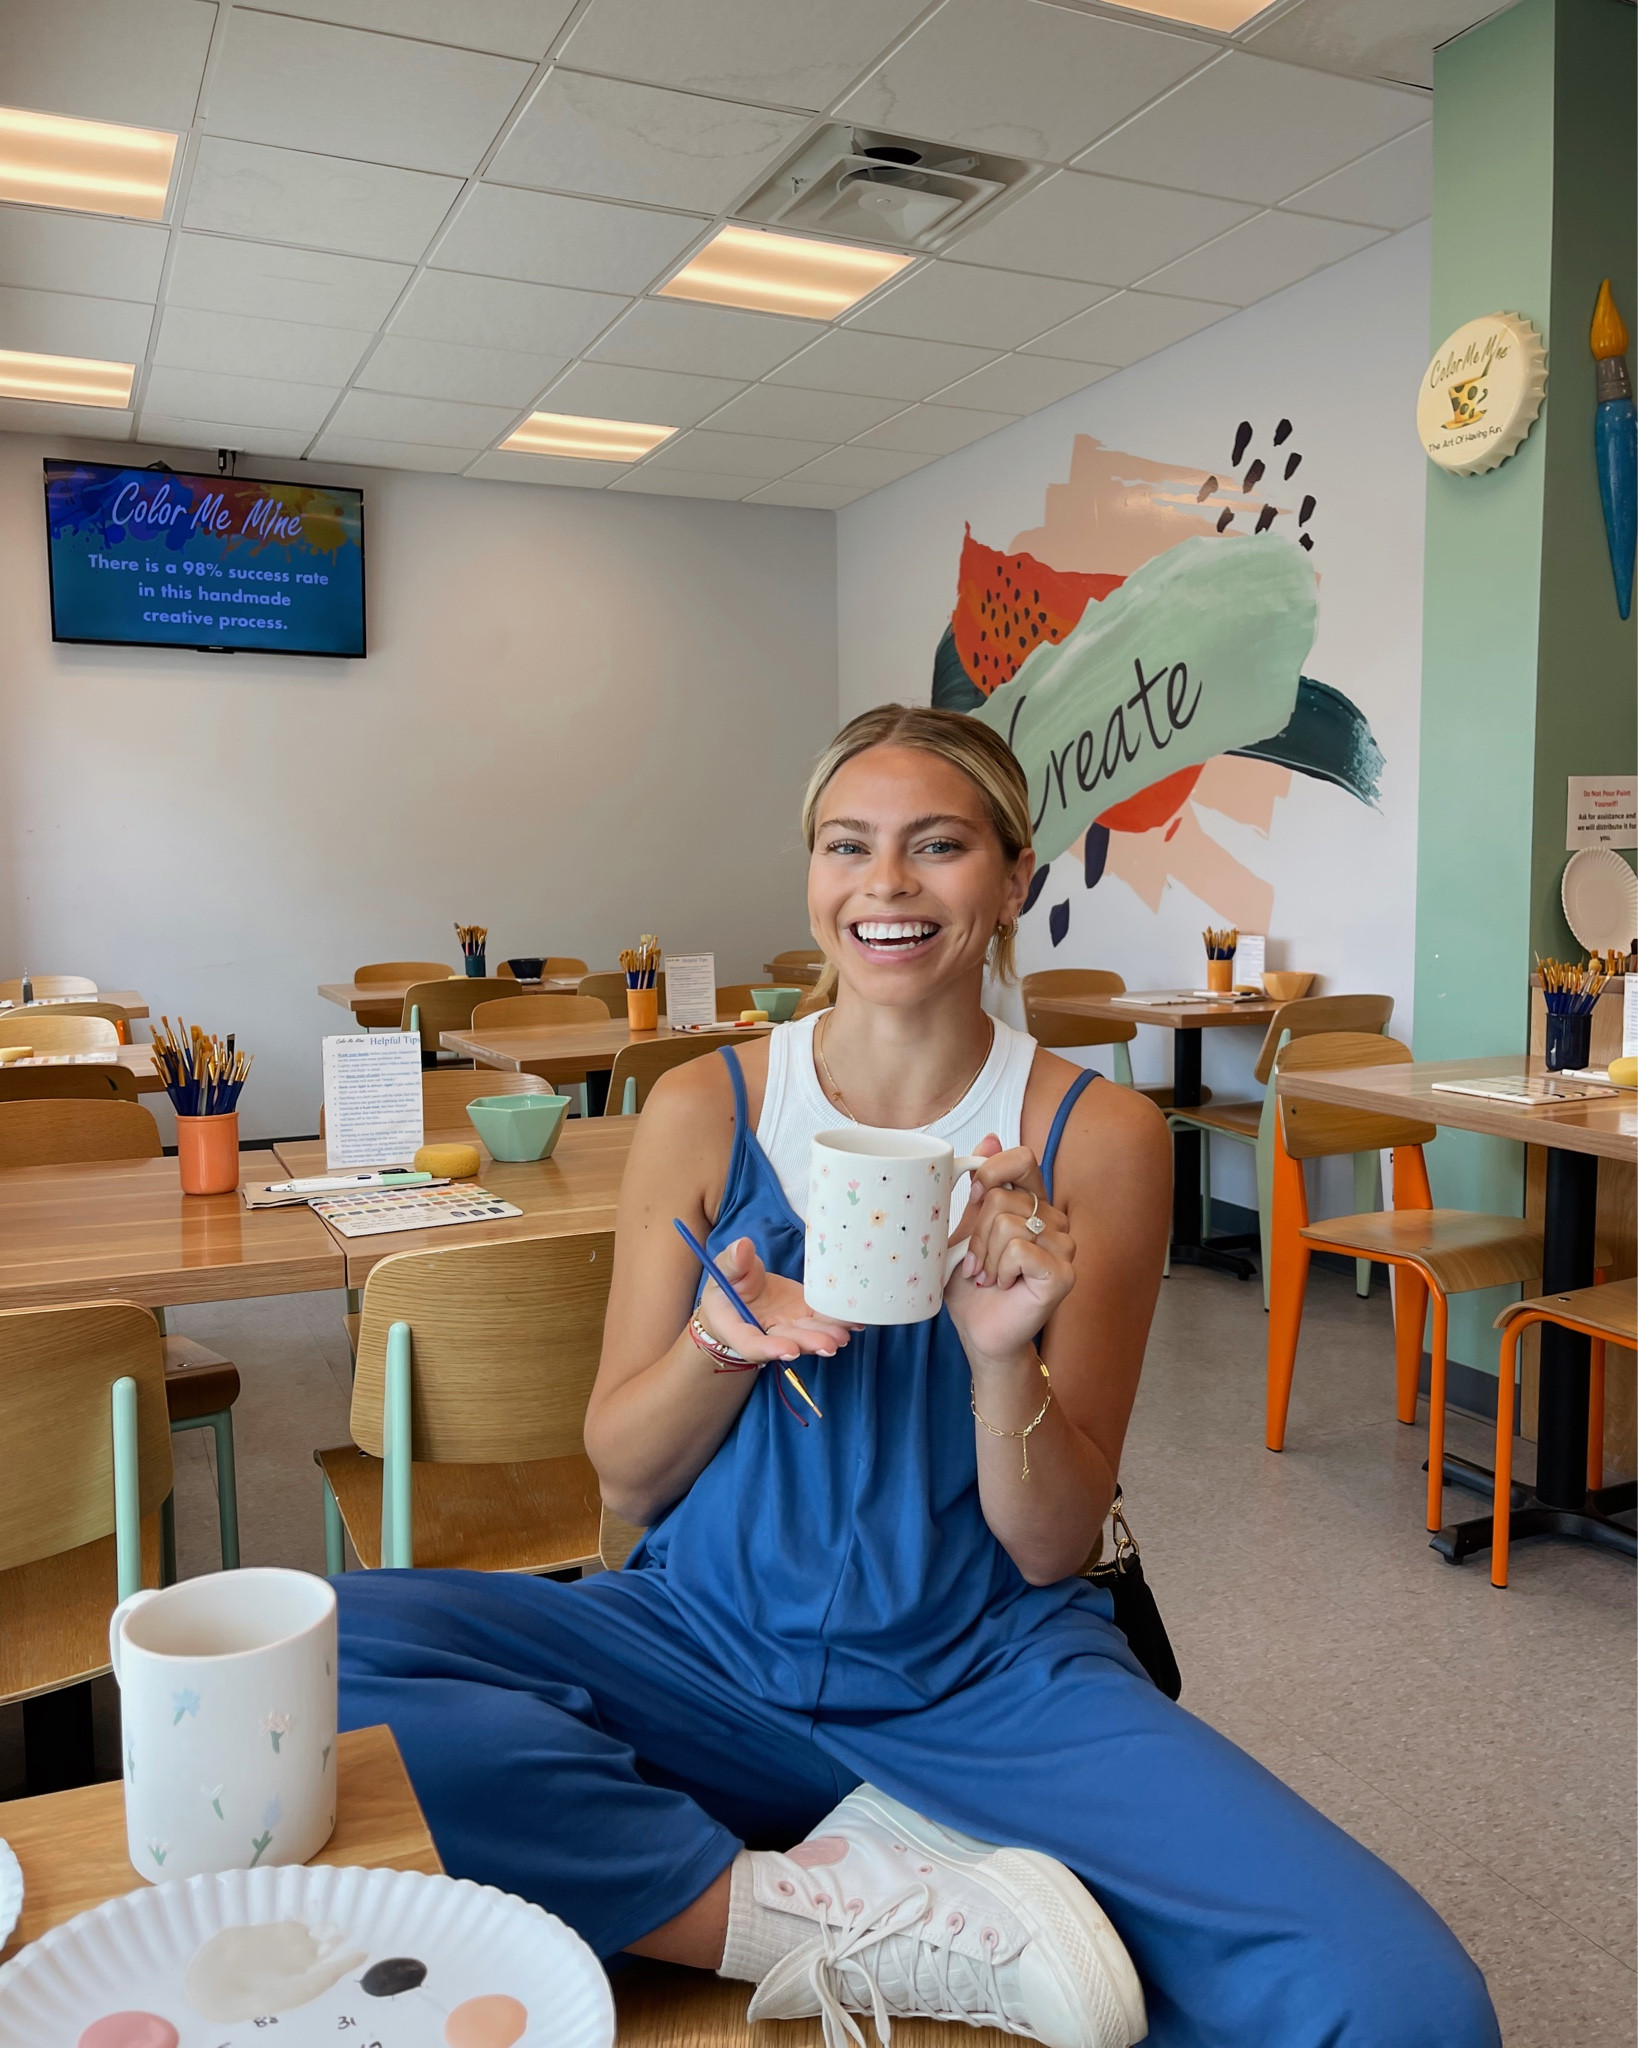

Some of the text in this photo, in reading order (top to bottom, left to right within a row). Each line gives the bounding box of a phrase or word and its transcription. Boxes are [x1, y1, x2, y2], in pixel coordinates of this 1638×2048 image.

[1430, 334, 1509, 388] Color Me Mine
[1428, 443, 1441, 453] The
[1442, 438, 1454, 448] Art
[1455, 434, 1465, 445] Of
[1465, 430, 1488, 443] Having
[112, 481, 303, 540] Color Me Mine
[88, 554, 330, 586] There is a 98% success rate
[138, 582, 292, 607] in this handmade
[143, 609, 289, 631] creative process.
[1616, 789, 1631, 797] Paint
[1596, 823, 1623, 831] distribute
[1597, 812, 1625, 820] assistance
[1600, 835, 1612, 843] you.
[370, 1036, 401, 1047] Helpful
